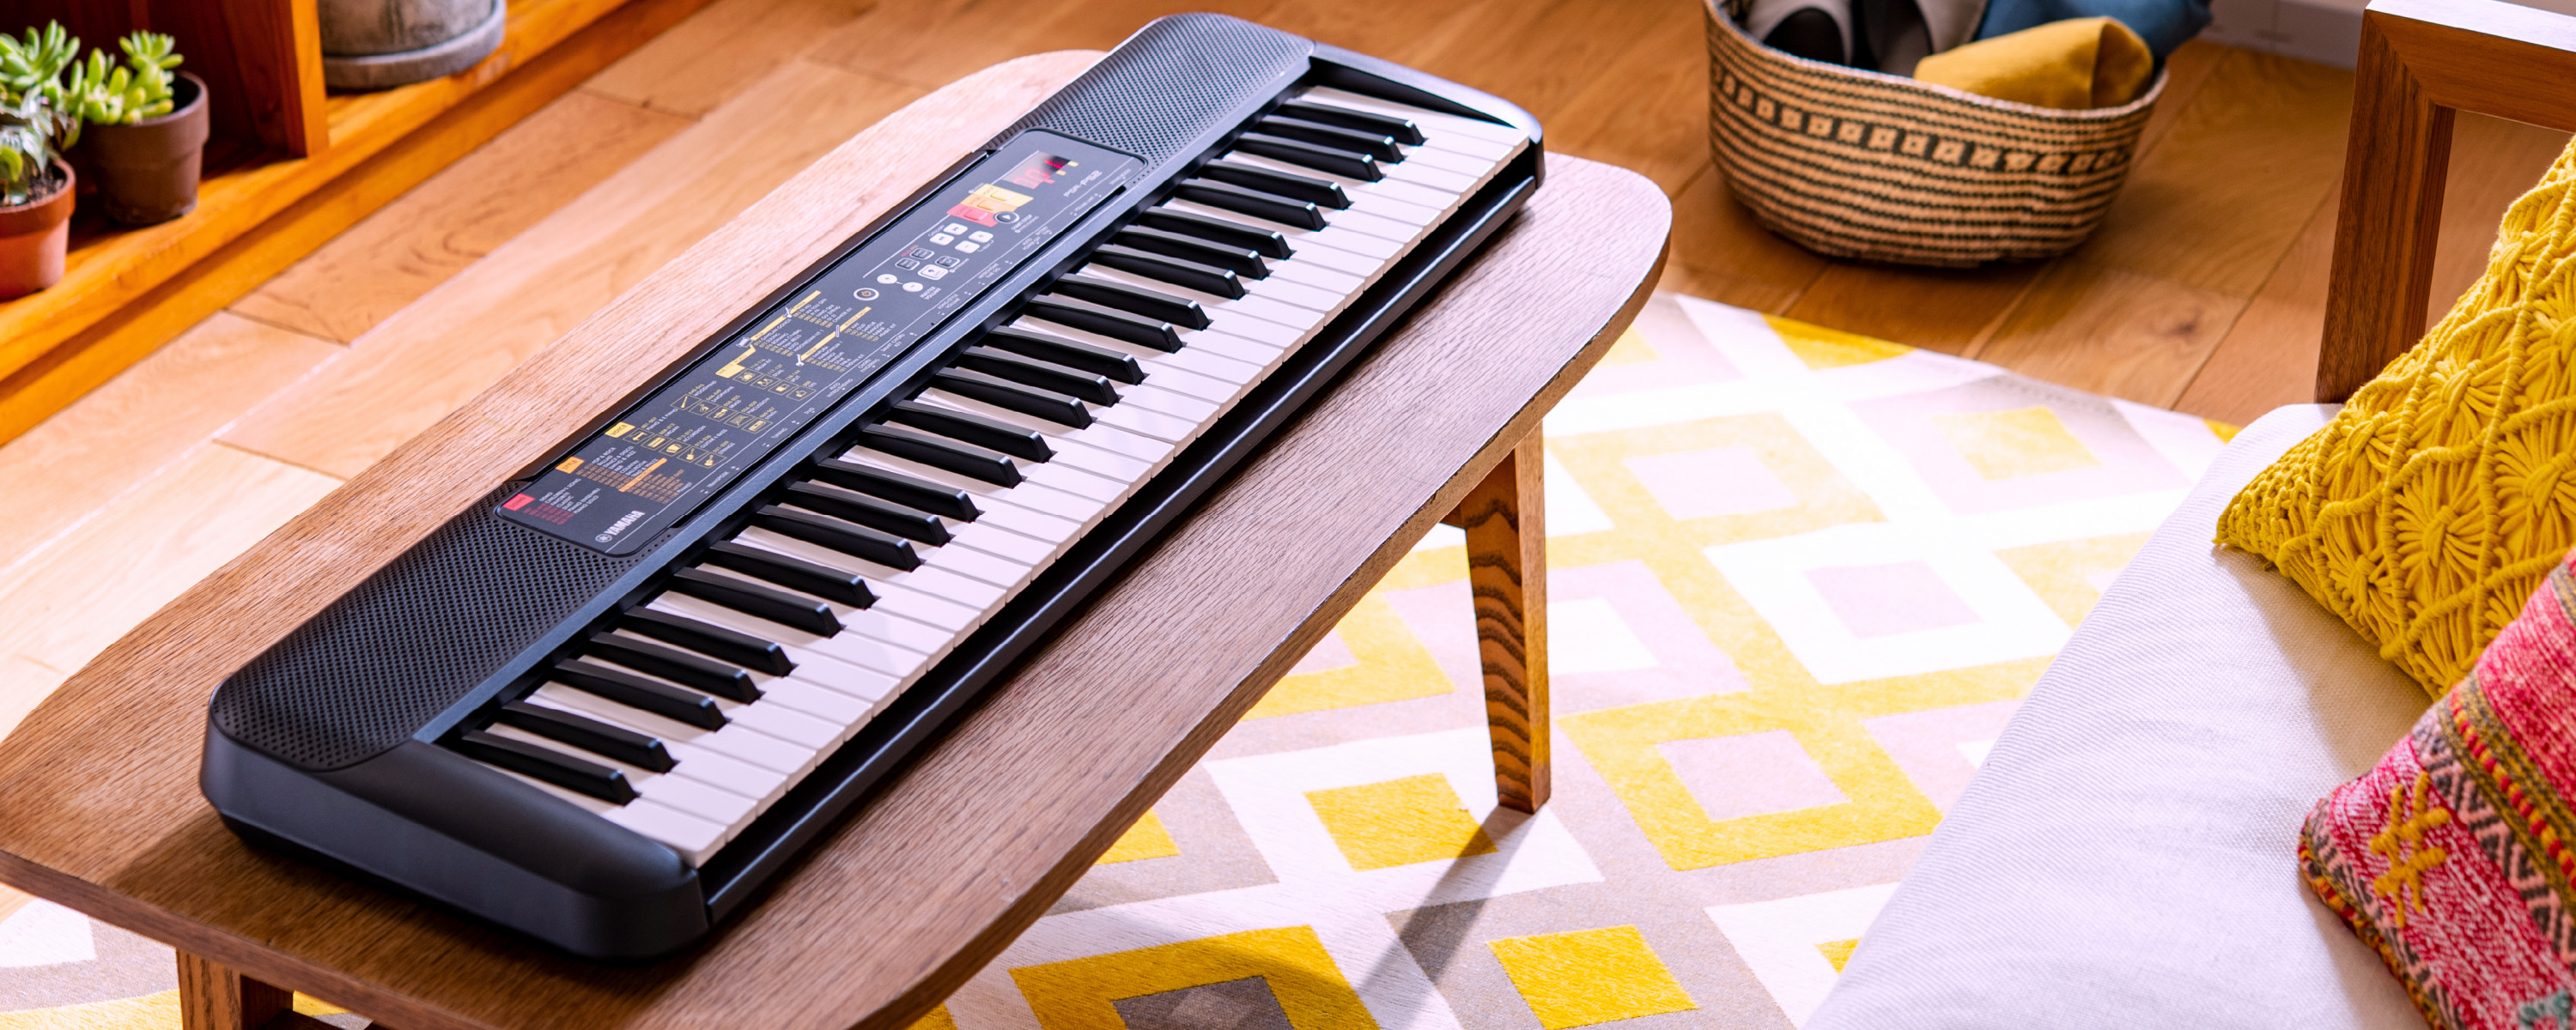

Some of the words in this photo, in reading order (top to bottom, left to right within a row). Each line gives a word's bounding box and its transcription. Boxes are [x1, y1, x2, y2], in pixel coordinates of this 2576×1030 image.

[1012, 215, 1032, 230] START/STOP
[920, 287, 935, 298] MASTER
[925, 288, 941, 300] VOLUME
[946, 298, 960, 308] VOLUME
[828, 306, 841, 315] ZHENG
[833, 312, 848, 322] CHINESE
[761, 329, 778, 340] GAMELAN
[777, 318, 791, 329] GONGS
[862, 322, 876, 332] SANTUR
[867, 322, 884, 334] KANOON
[766, 333, 780, 342] SULING
[771, 333, 788, 344] BONANG
[787, 330, 801, 339] CYMBAL
[793, 336, 816, 351] INDONESIAN
[881, 343, 892, 352] SMART
[891, 334, 905, 343] CHORD
[817, 343, 840, 360] HARMONIUM
[829, 352, 844, 362] BANSURI
[845, 359, 859, 367] INDIAN
[858, 360, 871, 368] CHORD
[860, 359, 879, 372] FINGERING
[694, 381, 716, 396] WOODWIND
[711, 386, 734, 402] SAXOPHONE
[747, 398, 769, 414] PERCUSSION
[765, 411, 777, 420] SYNTH
[611, 425, 627, 434] VOICE
[647, 421, 659, 430] PIANO
[665, 426, 679, 436] ORGAN
[683, 426, 706, 442] ACCORDION
[771, 428, 787, 438] TUNING
[701, 438, 714, 448] GUITAR
[718, 443, 735, 454] STRINGS
[597, 456, 612, 465] BALLAD
[603, 457, 617, 468] DANCE
[619, 446, 634, 456] DISCO
[562, 460, 576, 469] STYLE
[609, 460, 623, 470] SWING
[620, 460, 639, 473] COUNTRY
[625, 461, 647, 476] BALLROOM
[568, 479, 580, 488] SONG
[648, 474, 662, 483] CHINA
[666, 479, 680, 489] AFRICA
[707, 471, 729, 488] TRANSPOSE
[539, 492, 553, 501] DEMO
[550, 492, 569, 506] FAVORITE
[556, 495, 574, 507] CLASSIC
[568, 502, 582, 512] PIANO
[580, 488, 600, 502] ENSEMBLE
[562, 501, 573, 510] DUET
[574, 504, 587, 513] PIANO
[586, 495, 598, 504] SOLO
[605, 511, 644, 535] YAMAHA
